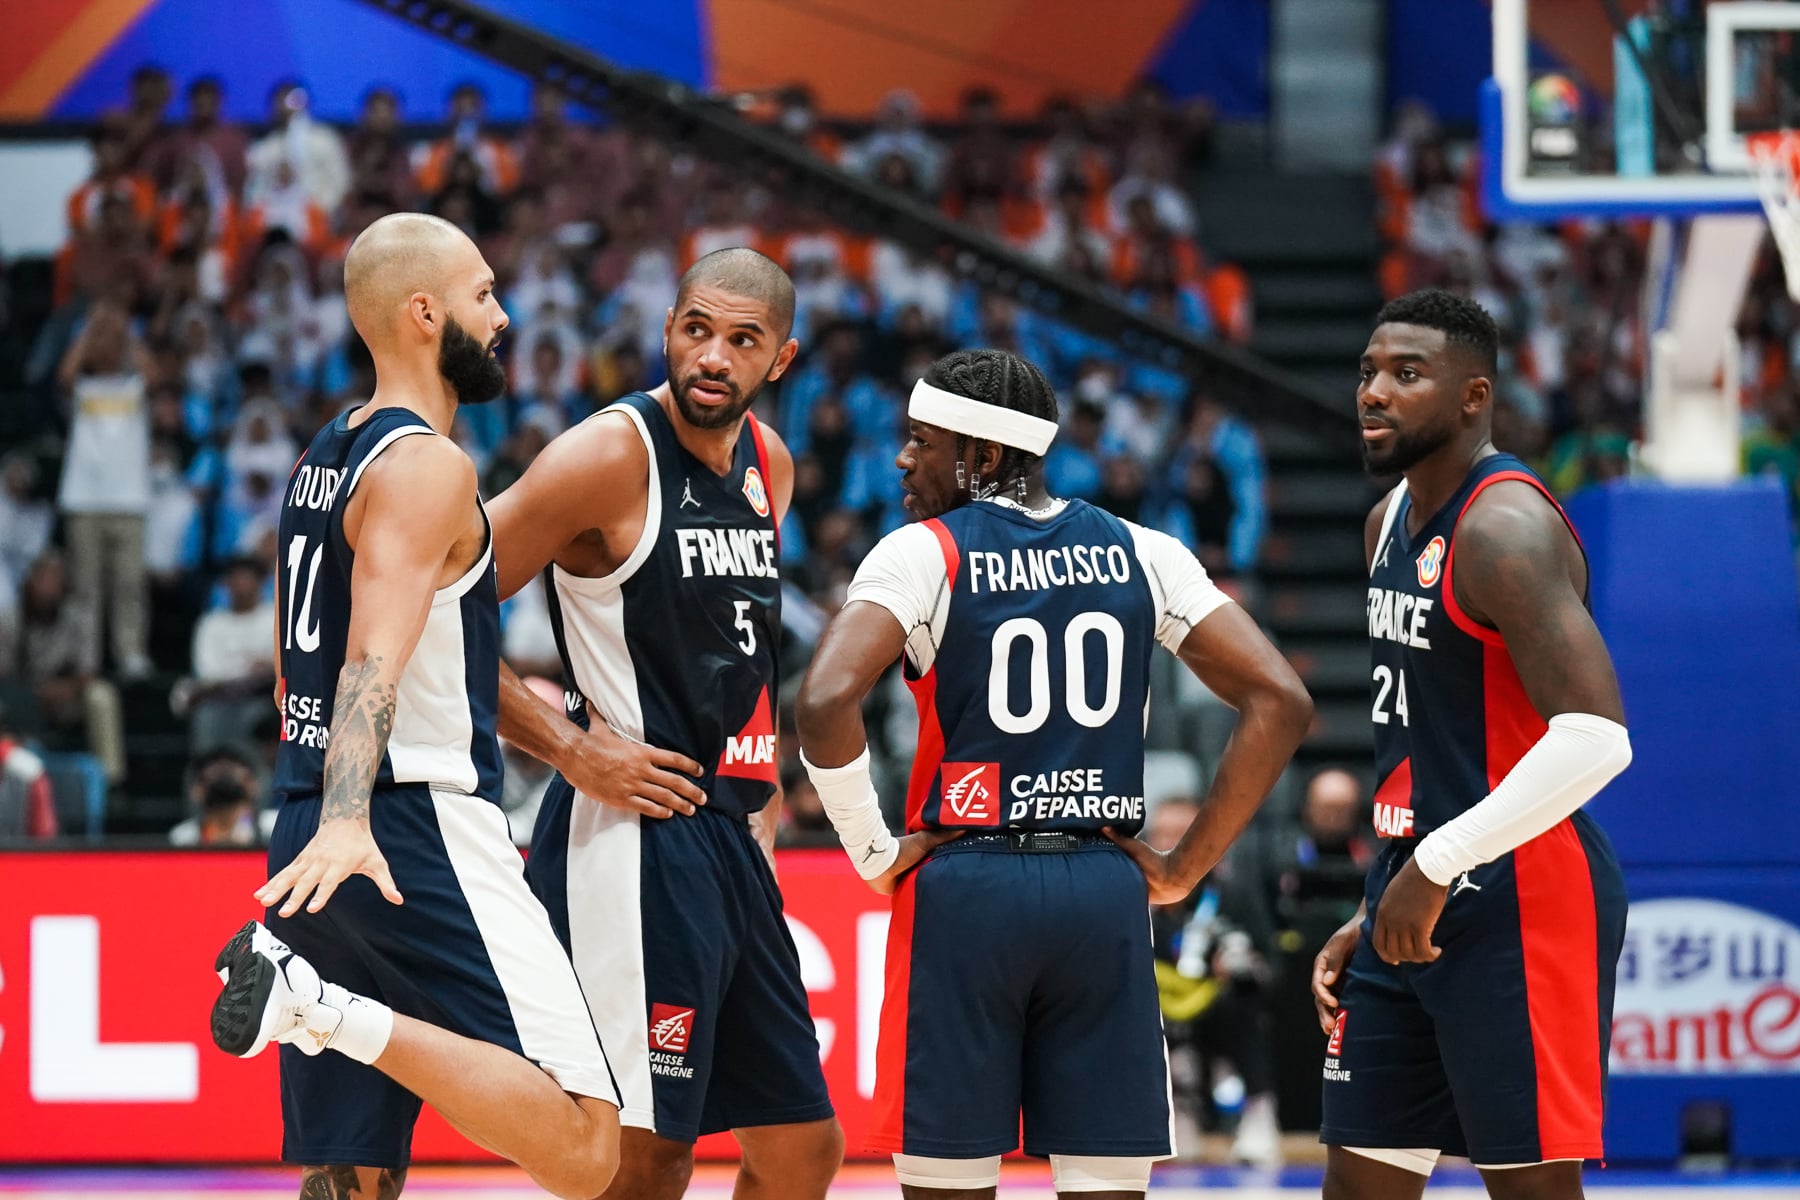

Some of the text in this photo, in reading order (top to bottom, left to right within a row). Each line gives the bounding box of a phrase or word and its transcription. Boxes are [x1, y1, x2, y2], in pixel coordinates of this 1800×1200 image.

[675, 528, 779, 579] FRANCE
[968, 544, 1130, 593] FRANCISCO
[733, 601, 757, 656] 5
[988, 611, 1125, 734] 00
[1371, 664, 1409, 727] 24
[1008, 796, 1144, 820] D'EPARGNE
[1010, 768, 1104, 798] CAISSE
[649, 1051, 685, 1066] CAISSE
